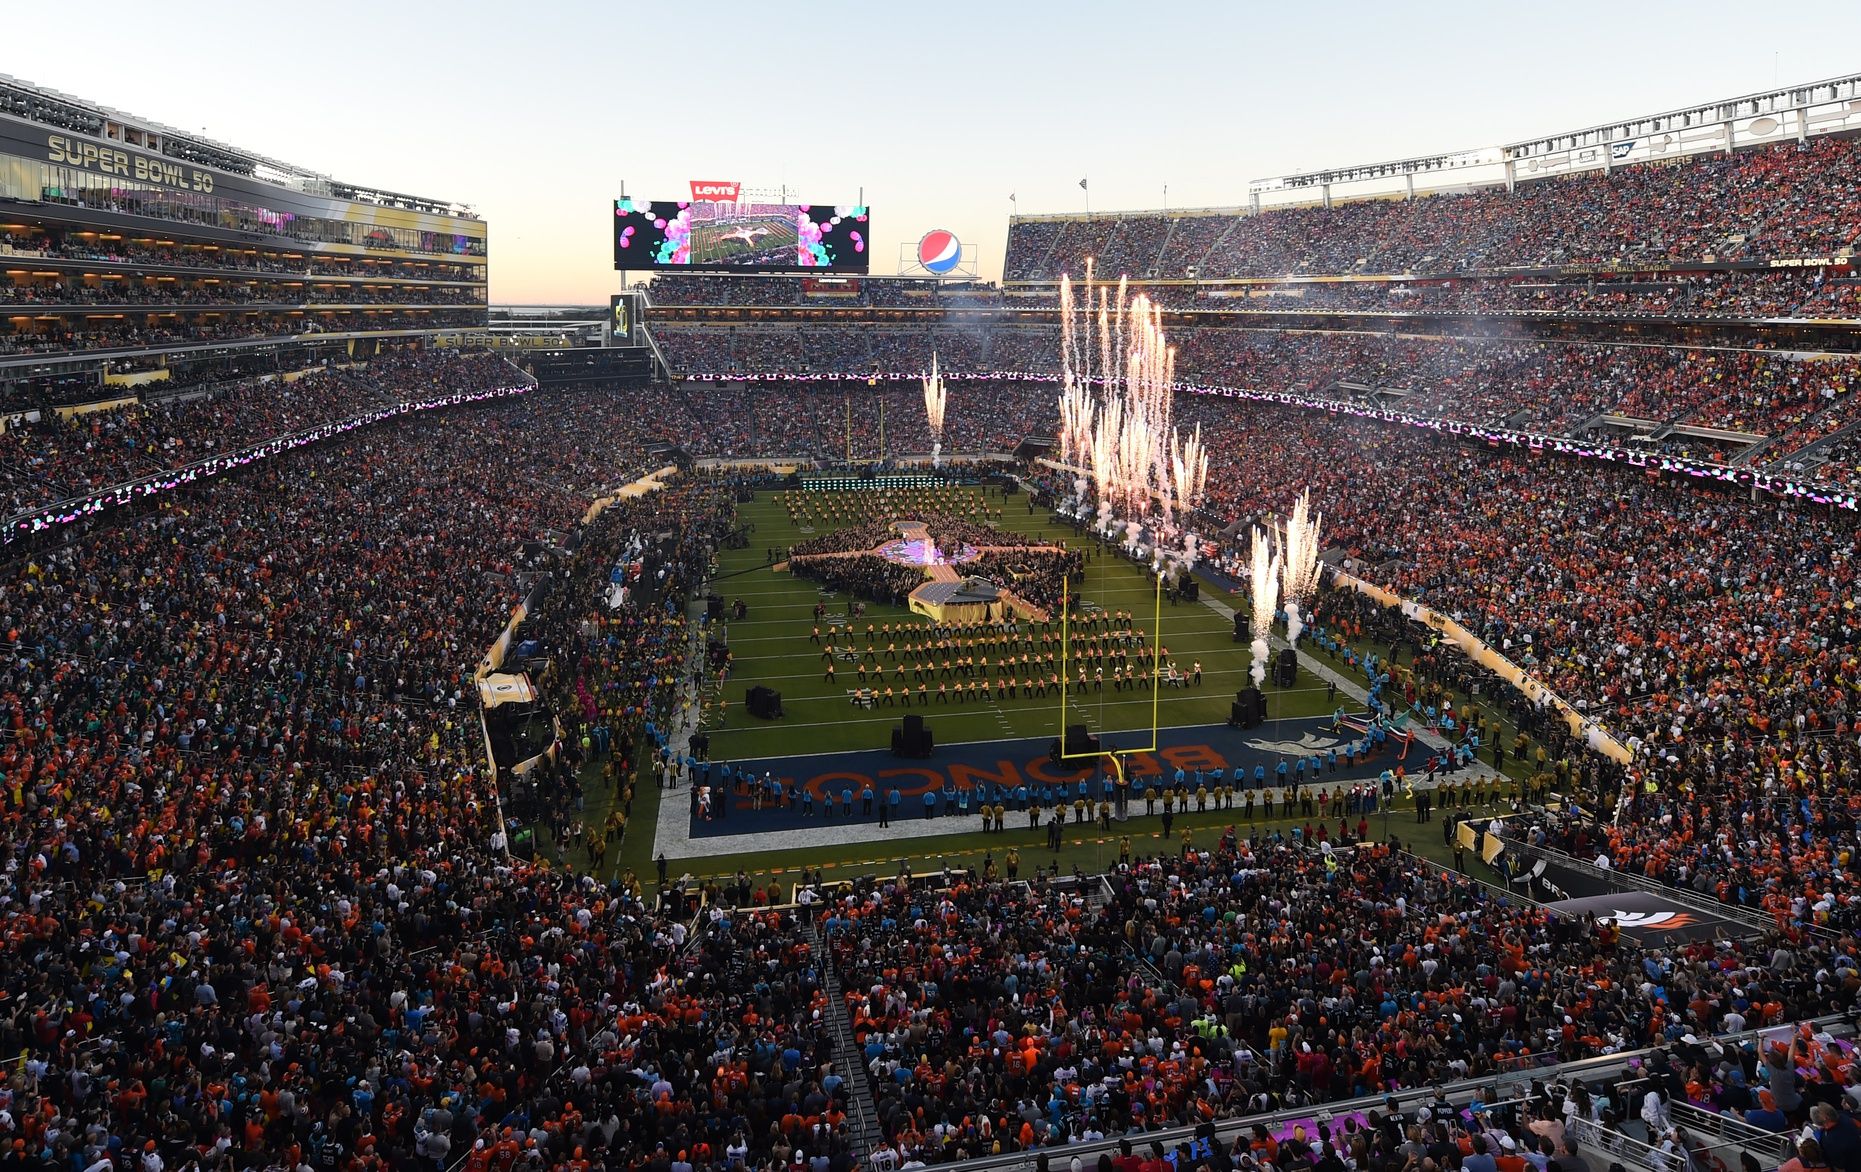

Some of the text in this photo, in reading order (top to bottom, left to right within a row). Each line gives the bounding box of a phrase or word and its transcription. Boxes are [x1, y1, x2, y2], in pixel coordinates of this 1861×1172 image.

[1613, 145, 1630, 156] SAP
[48, 135, 213, 193] SUPER BOWL 50
[1770, 257, 1848, 268] SUPER BOWL 50
[1560, 264, 1671, 275] NATIONAL FOOTBALL LEAGUE
[446, 337, 560, 347] SUPER BOWL 50
